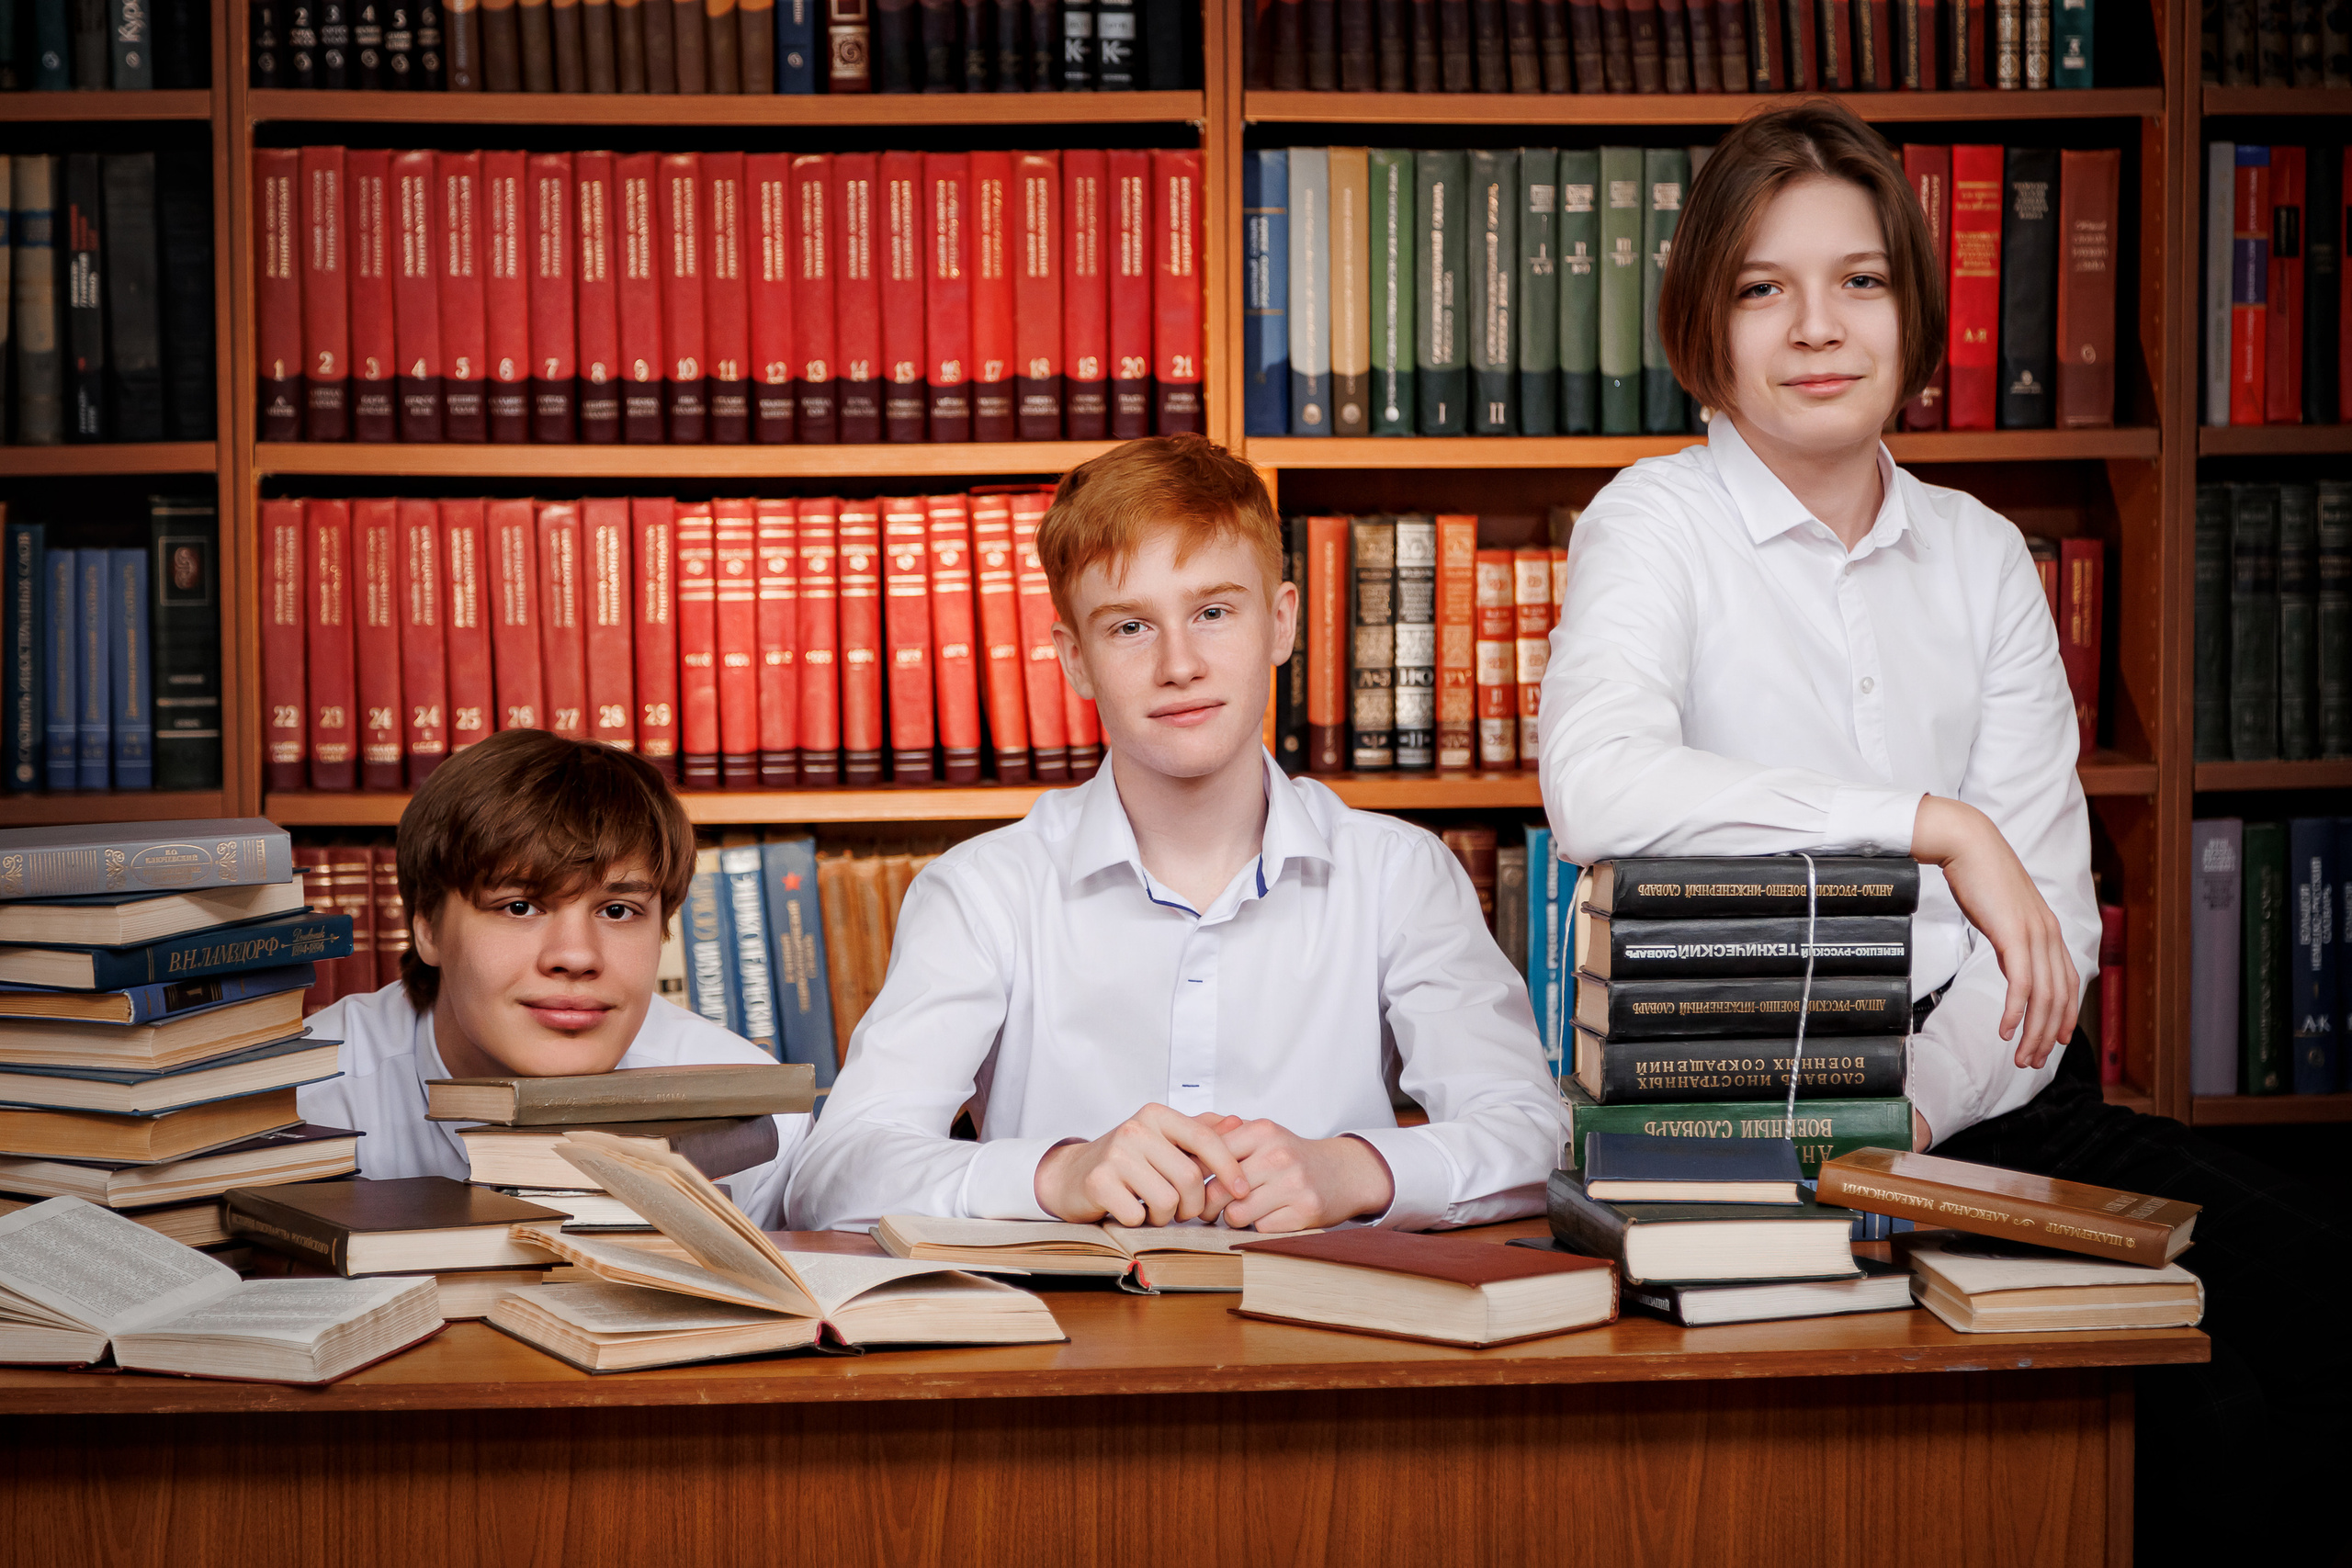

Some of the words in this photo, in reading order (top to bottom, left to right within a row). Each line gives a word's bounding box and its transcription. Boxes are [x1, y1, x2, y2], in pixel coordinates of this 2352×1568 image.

[295, 7, 309, 26] 2
[325, 5, 340, 23] 3
[362, 5, 375, 23] 4
[393, 9, 407, 28] 5
[274, 357, 284, 382] 1
[318, 350, 334, 375] 2
[366, 356, 380, 380] 3
[411, 356, 427, 382] 4
[455, 355, 470, 381] 5
[499, 356, 514, 381] 6
[544, 356, 560, 381] 7
[591, 361, 606, 385] 8
[634, 358, 649, 383] 9
[676, 356, 698, 381] 10
[718, 358, 738, 382] 11
[764, 361, 787, 384] 12
[806, 358, 827, 383] 13
[850, 358, 869, 382] 14
[894, 359, 916, 385] 15
[940, 358, 961, 382] 16
[984, 358, 1003, 382] 17
[1029, 356, 1051, 380] 18
[1077, 355, 1098, 380] 19
[1121, 355, 1146, 380] 20
[1171, 355, 1193, 378] 21
[273, 705, 300, 728] 22
[320, 705, 345, 728] 23
[368, 706, 392, 730] 24
[413, 705, 440, 728] 24
[456, 706, 481, 730] 25
[508, 705, 535, 728] 26
[555, 707, 580, 731] 27
[598, 704, 626, 728] 28
[645, 703, 672, 727] 29
[1638, 884, 1681, 897] СЛОВАРЬ
[1685, 884, 1807, 898] ВОЕННО-ИНЖЕНЕРНЫЙ
[1624, 947, 1677, 959] СЛОВАРЬ
[1678, 942, 1799, 959] ТЕХНИЧЕСКИЙ
[1633, 1002, 1675, 1015] СЛОВАРЬ
[1679, 1000, 1800, 1016] ВОЕННО-ИНЖЕНЕРНЫЙ
[1635, 1058, 1765, 1076] СОКРАЩЕНИЙ
[1772, 1056, 1865, 1071] ВОЕННЫХ
[1636, 1074, 1771, 1089] ИНОСТРАННЫХ
[1644, 1120, 1733, 1140] СЛОВАРЬ
[1841, 1181, 1935, 1211] МАКЕДОНСКИЙ
[1939, 1201, 2010, 1223] АЛЕКСАНДР
